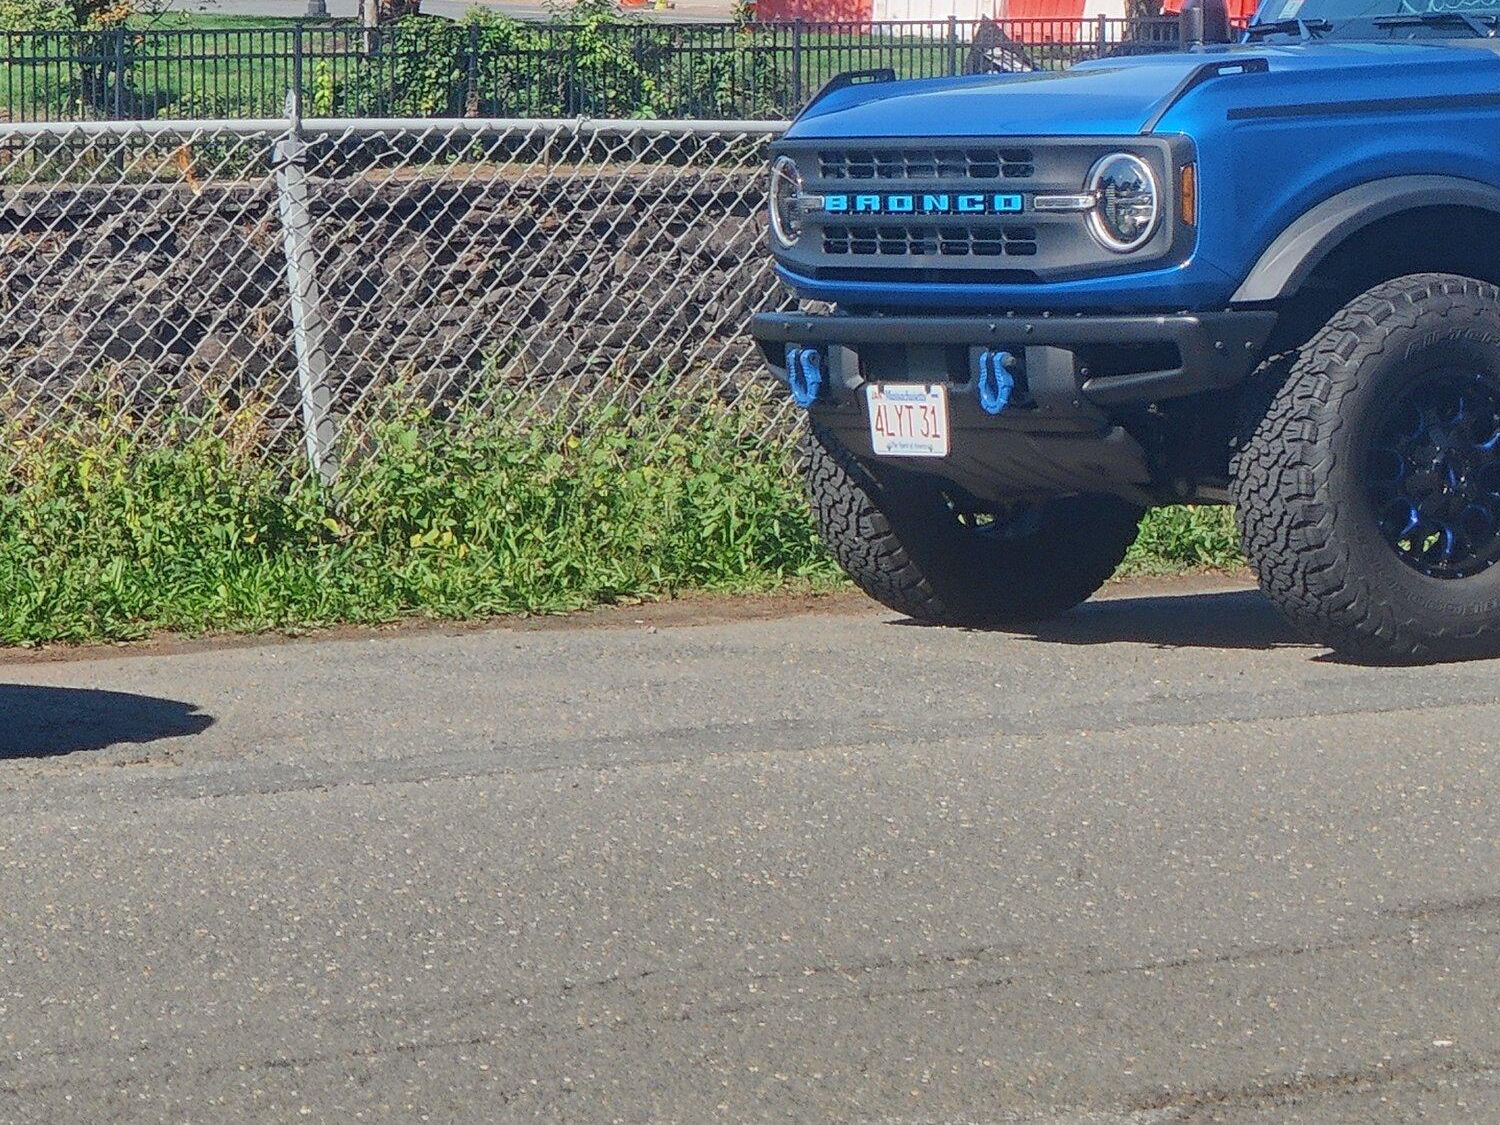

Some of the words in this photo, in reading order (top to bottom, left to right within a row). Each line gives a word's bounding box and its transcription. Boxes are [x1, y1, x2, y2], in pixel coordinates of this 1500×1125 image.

[825, 194, 1022, 212] BRONCO
[875, 404, 914, 438] 4LYT
[919, 405, 941, 438] 31
